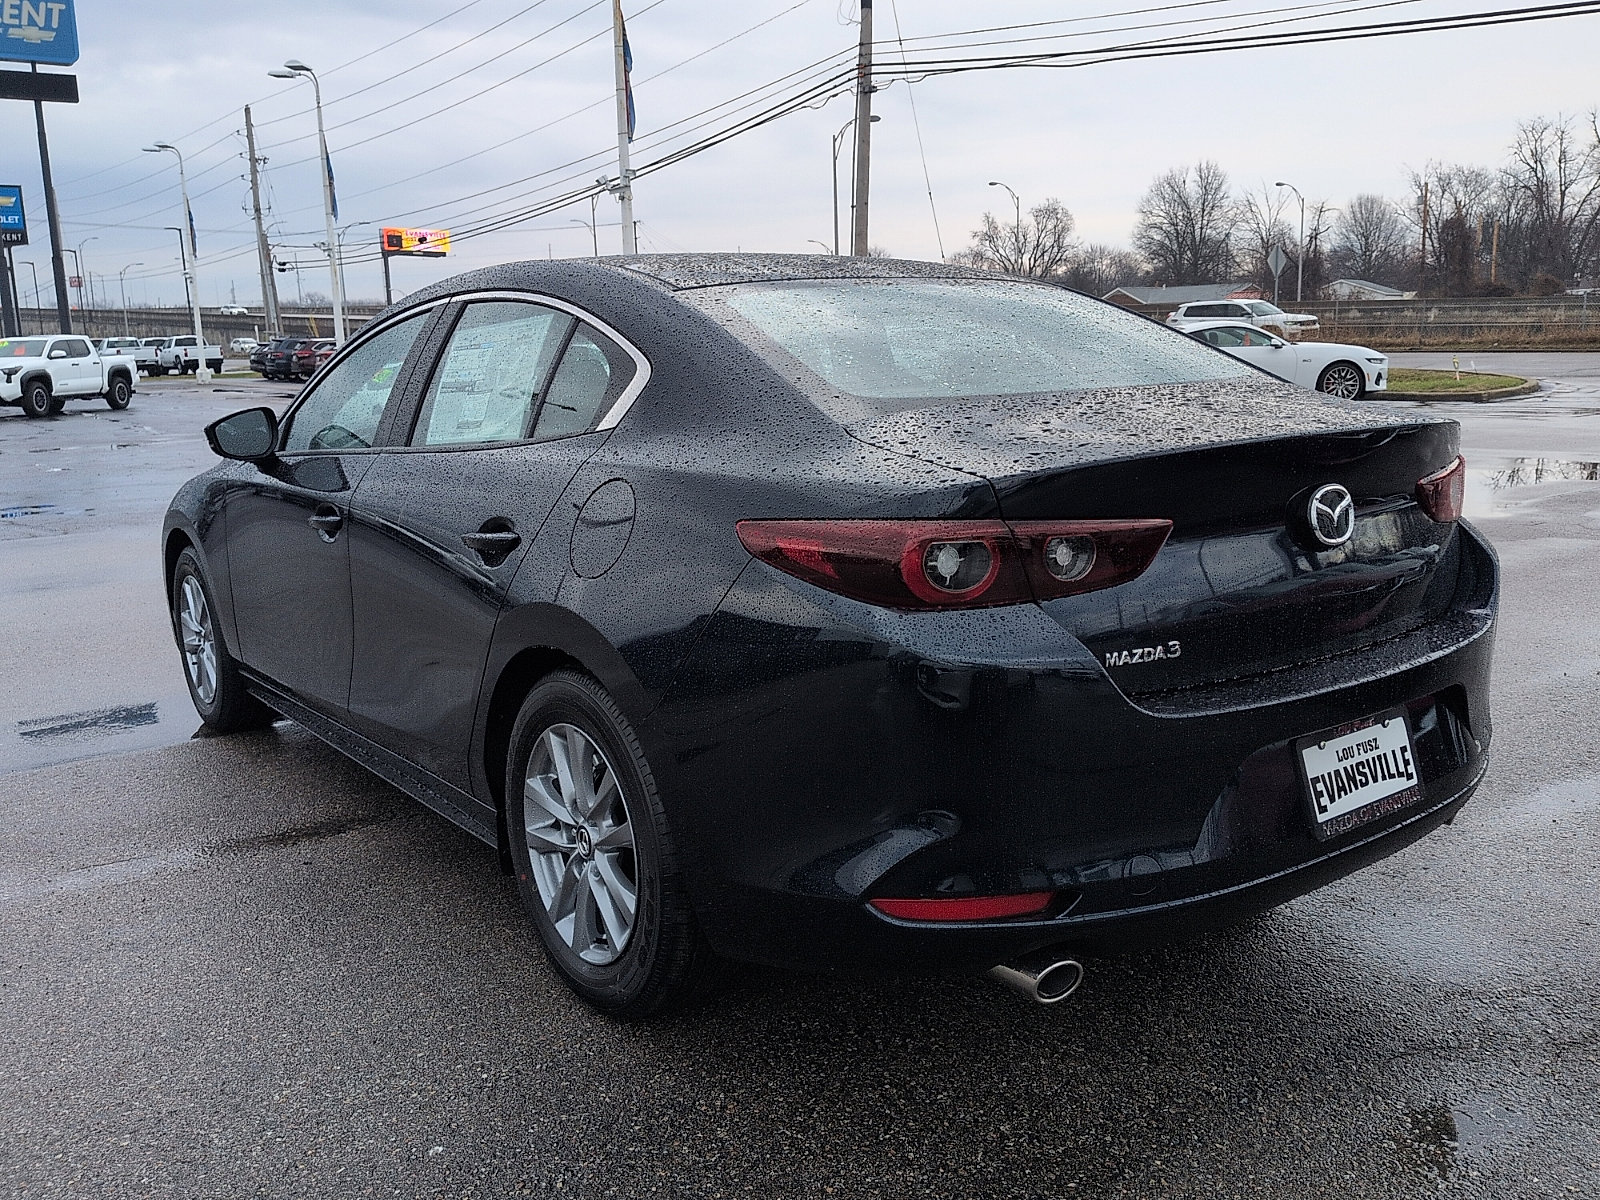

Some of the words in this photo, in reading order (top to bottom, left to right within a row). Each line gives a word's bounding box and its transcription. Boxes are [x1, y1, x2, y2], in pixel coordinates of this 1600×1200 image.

[0, 0, 66, 28] ENT
[405, 230, 446, 238] EVANSVILLE
[1335, 745, 1355, 762] LOU
[1355, 737, 1380, 756] FUSZ
[1310, 745, 1414, 815] EVANSVILLE
